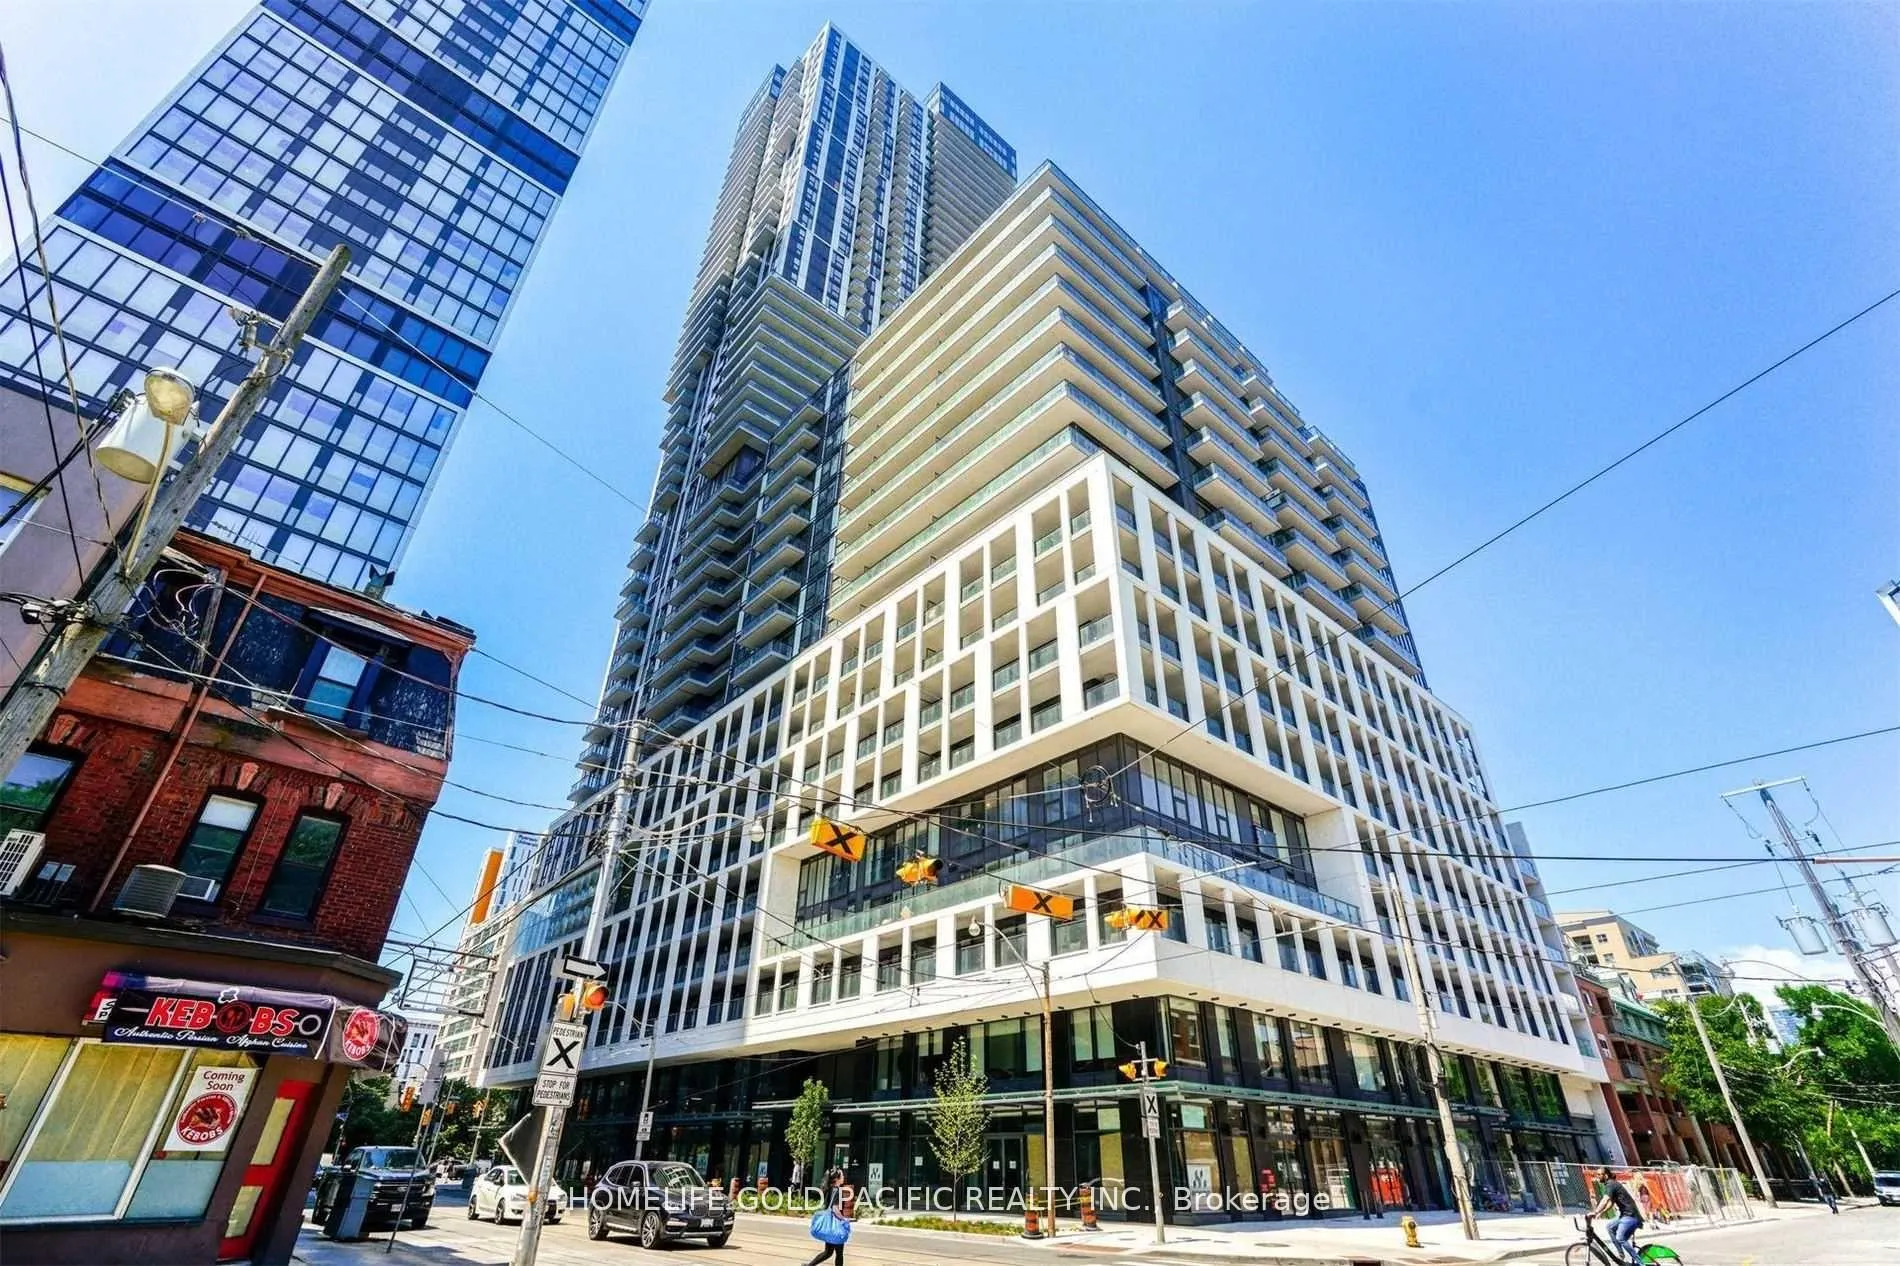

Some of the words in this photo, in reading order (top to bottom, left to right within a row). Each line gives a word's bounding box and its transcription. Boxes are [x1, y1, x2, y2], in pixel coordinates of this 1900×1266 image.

[114, 1026, 174, 1041] Authentic
[175, 1030, 219, 1043] Persian
[225, 1033, 270, 1048] Afghan
[271, 1038, 308, 1050] Cuisine
[553, 1026, 584, 1038] PEDESTRIAN
[203, 1070, 246, 1084] Coming
[206, 1080, 234, 1092] Soon
[542, 1079, 557, 1089] STOP
[559, 1080, 570, 1090] FOR
[536, 1089, 571, 1101] PEDESTRIANS
[180, 1126, 223, 1141] KEBOBS
